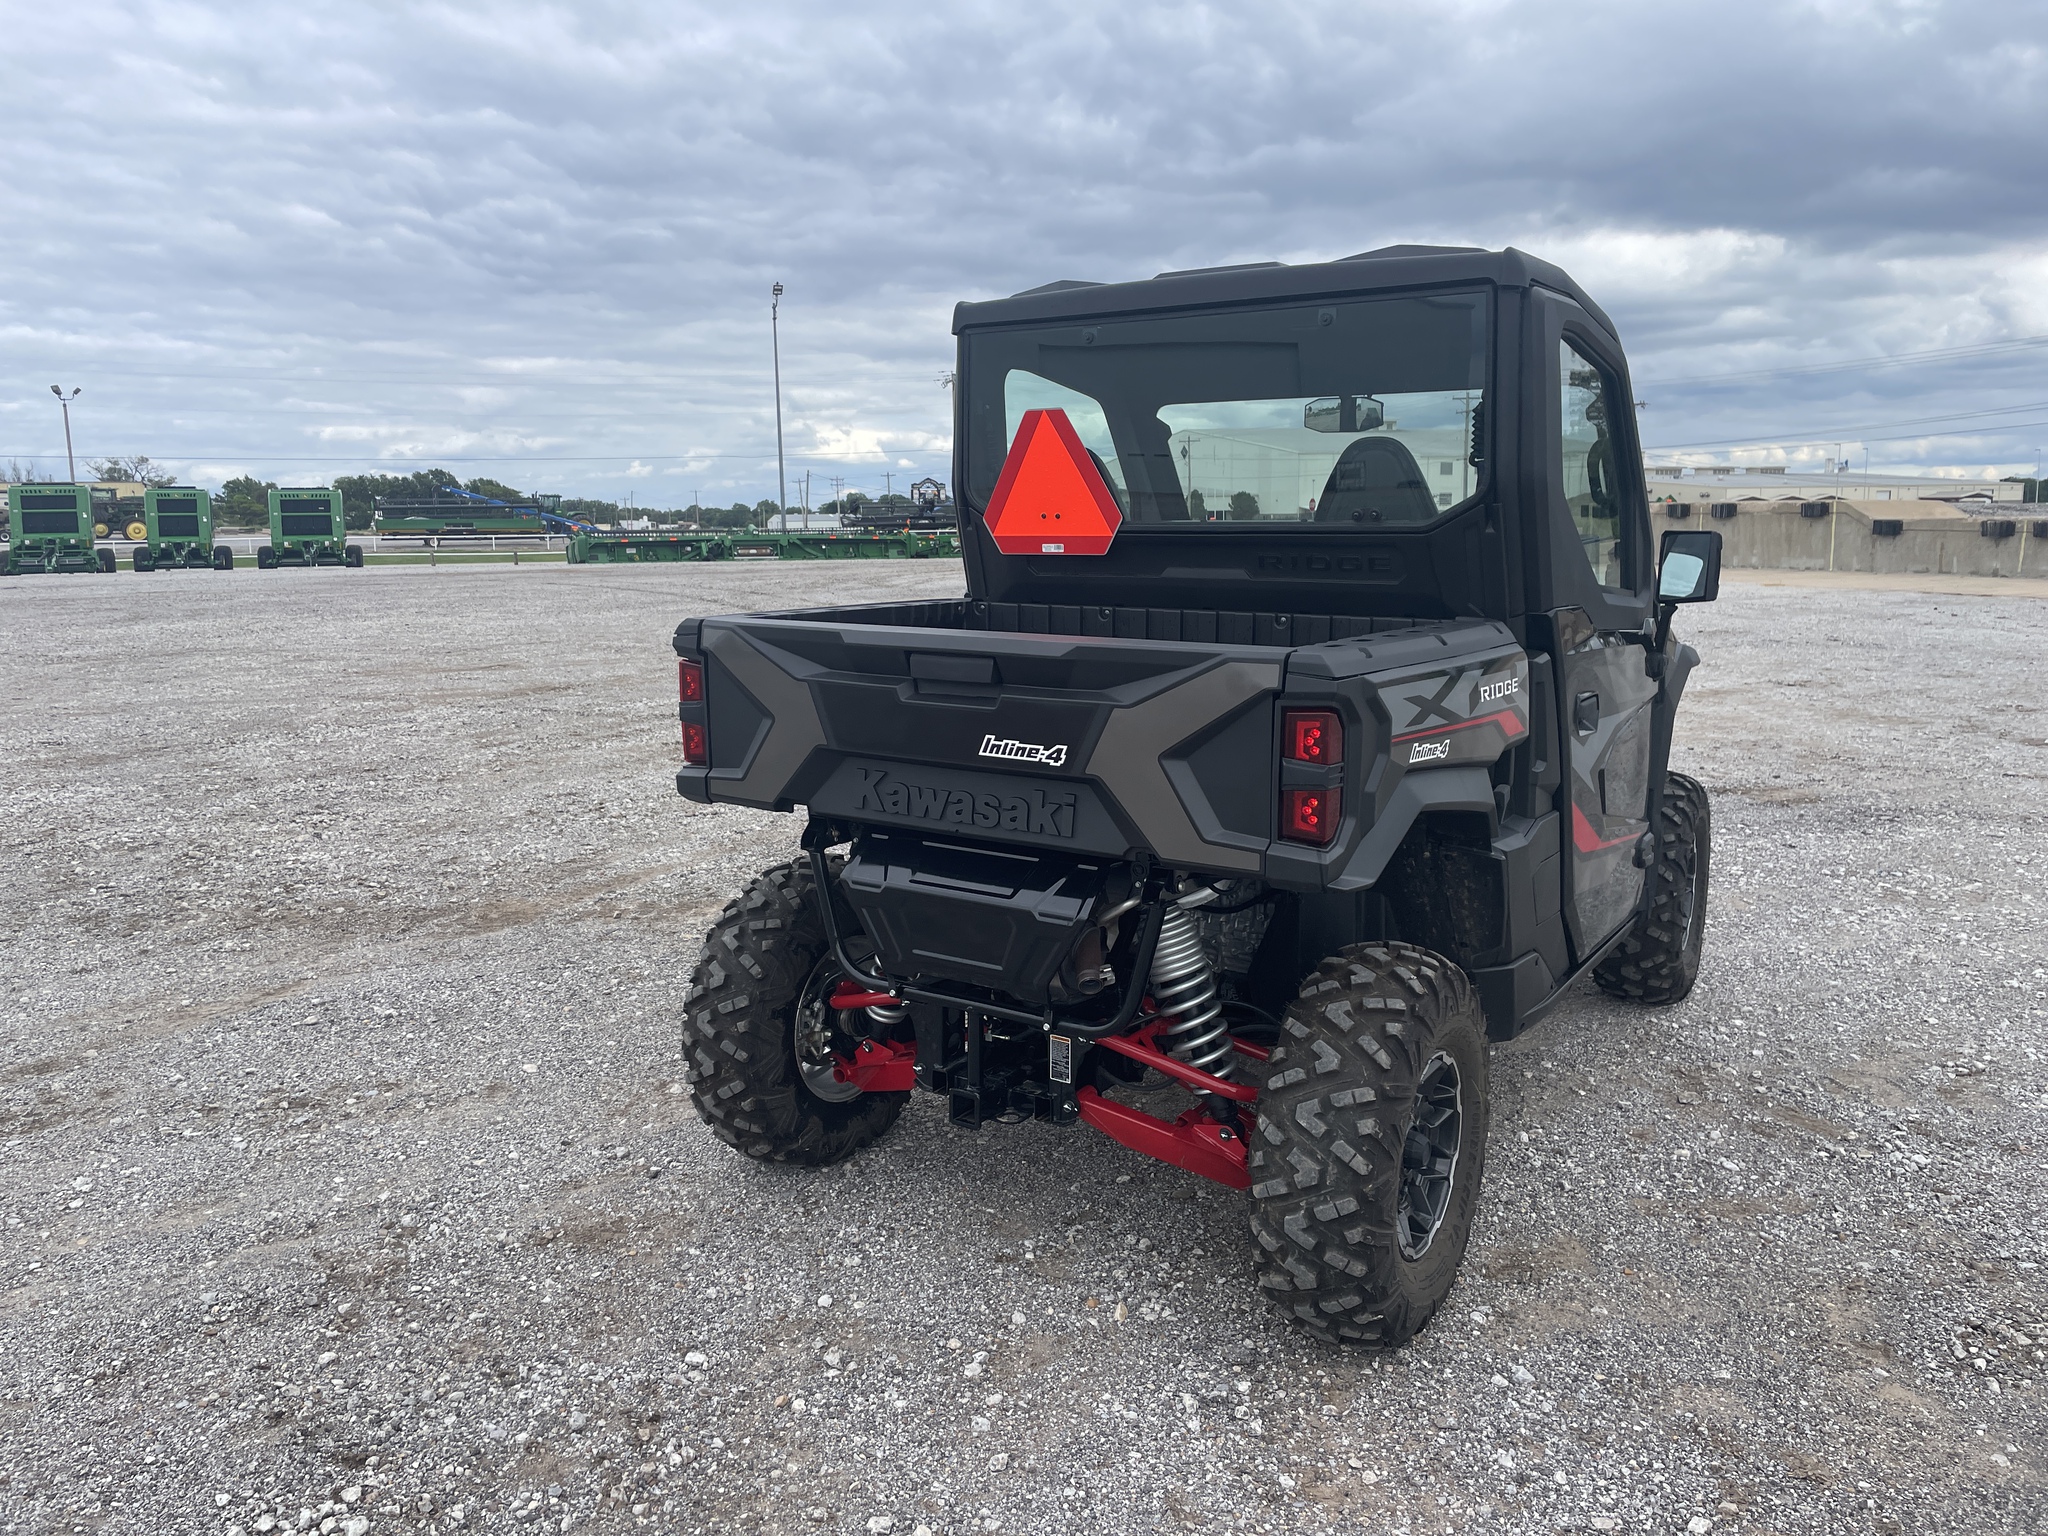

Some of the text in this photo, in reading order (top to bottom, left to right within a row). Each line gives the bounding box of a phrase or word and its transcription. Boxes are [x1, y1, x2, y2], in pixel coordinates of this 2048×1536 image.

[1257, 552, 1391, 571] RIDGE
[1480, 677, 1519, 702] RIDGE
[978, 734, 1068, 766] Inline-4
[1409, 739, 1450, 763] Inline-4
[853, 767, 1077, 838] Kawasaki
